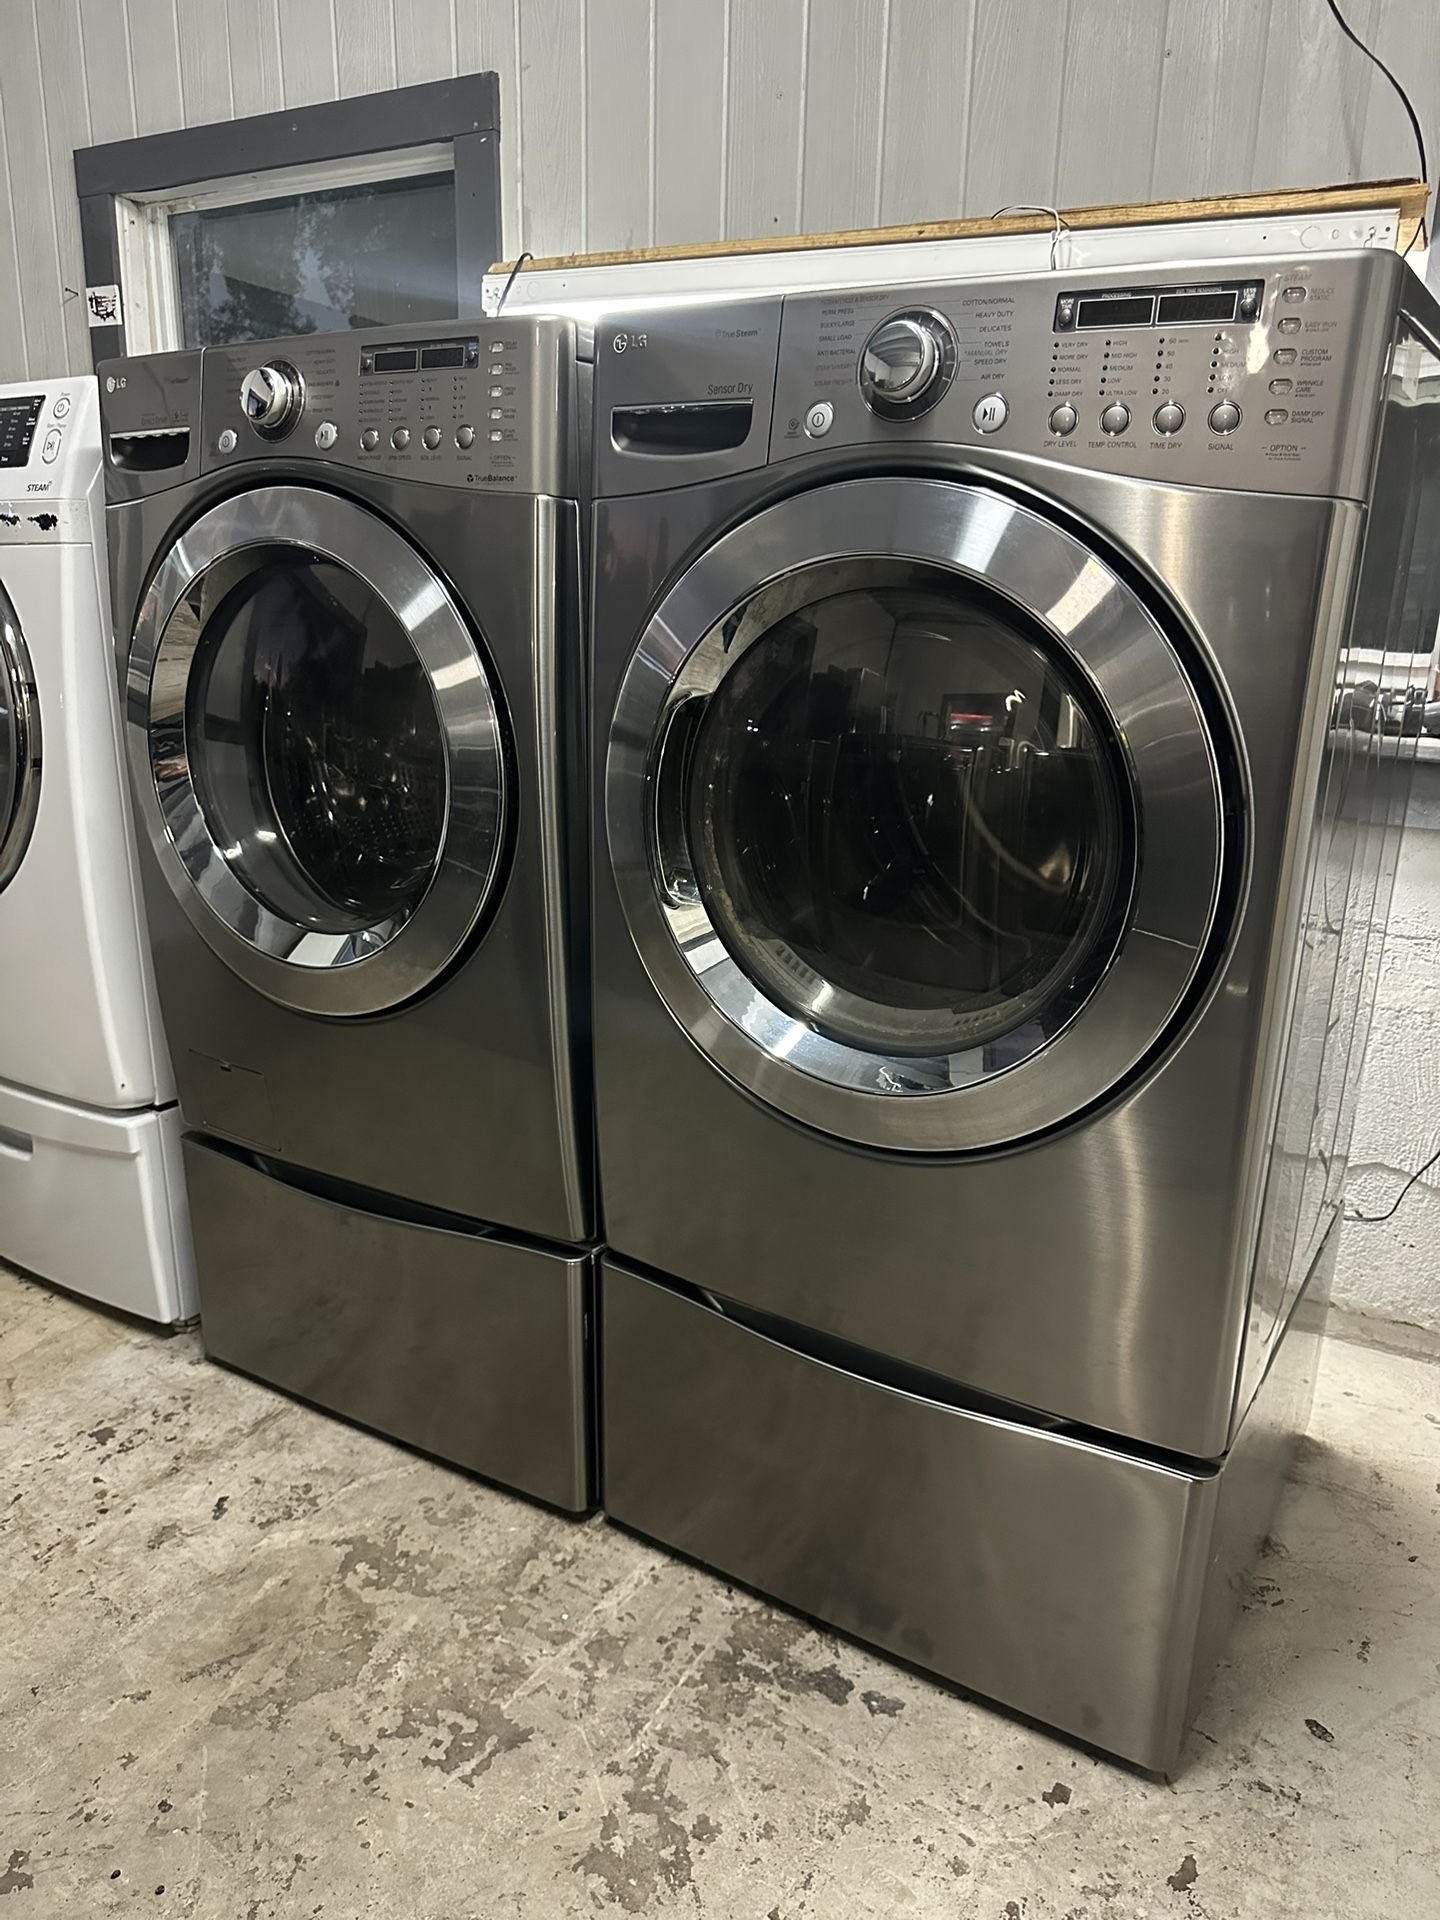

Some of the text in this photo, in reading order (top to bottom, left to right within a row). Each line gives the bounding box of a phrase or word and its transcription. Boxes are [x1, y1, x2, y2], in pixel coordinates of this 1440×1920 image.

[979, 325, 1012, 333] DELICATES
[974, 358, 994, 366] SPEED
[116, 378, 126, 389] LG
[708, 382, 754, 396] Sensor Dry
[1044, 440, 1077, 448] DRY LEVEL
[1107, 440, 1137, 449] CONTROL
[1208, 443, 1234, 451] SIGNAL
[27, 484, 49, 492] STEAM
